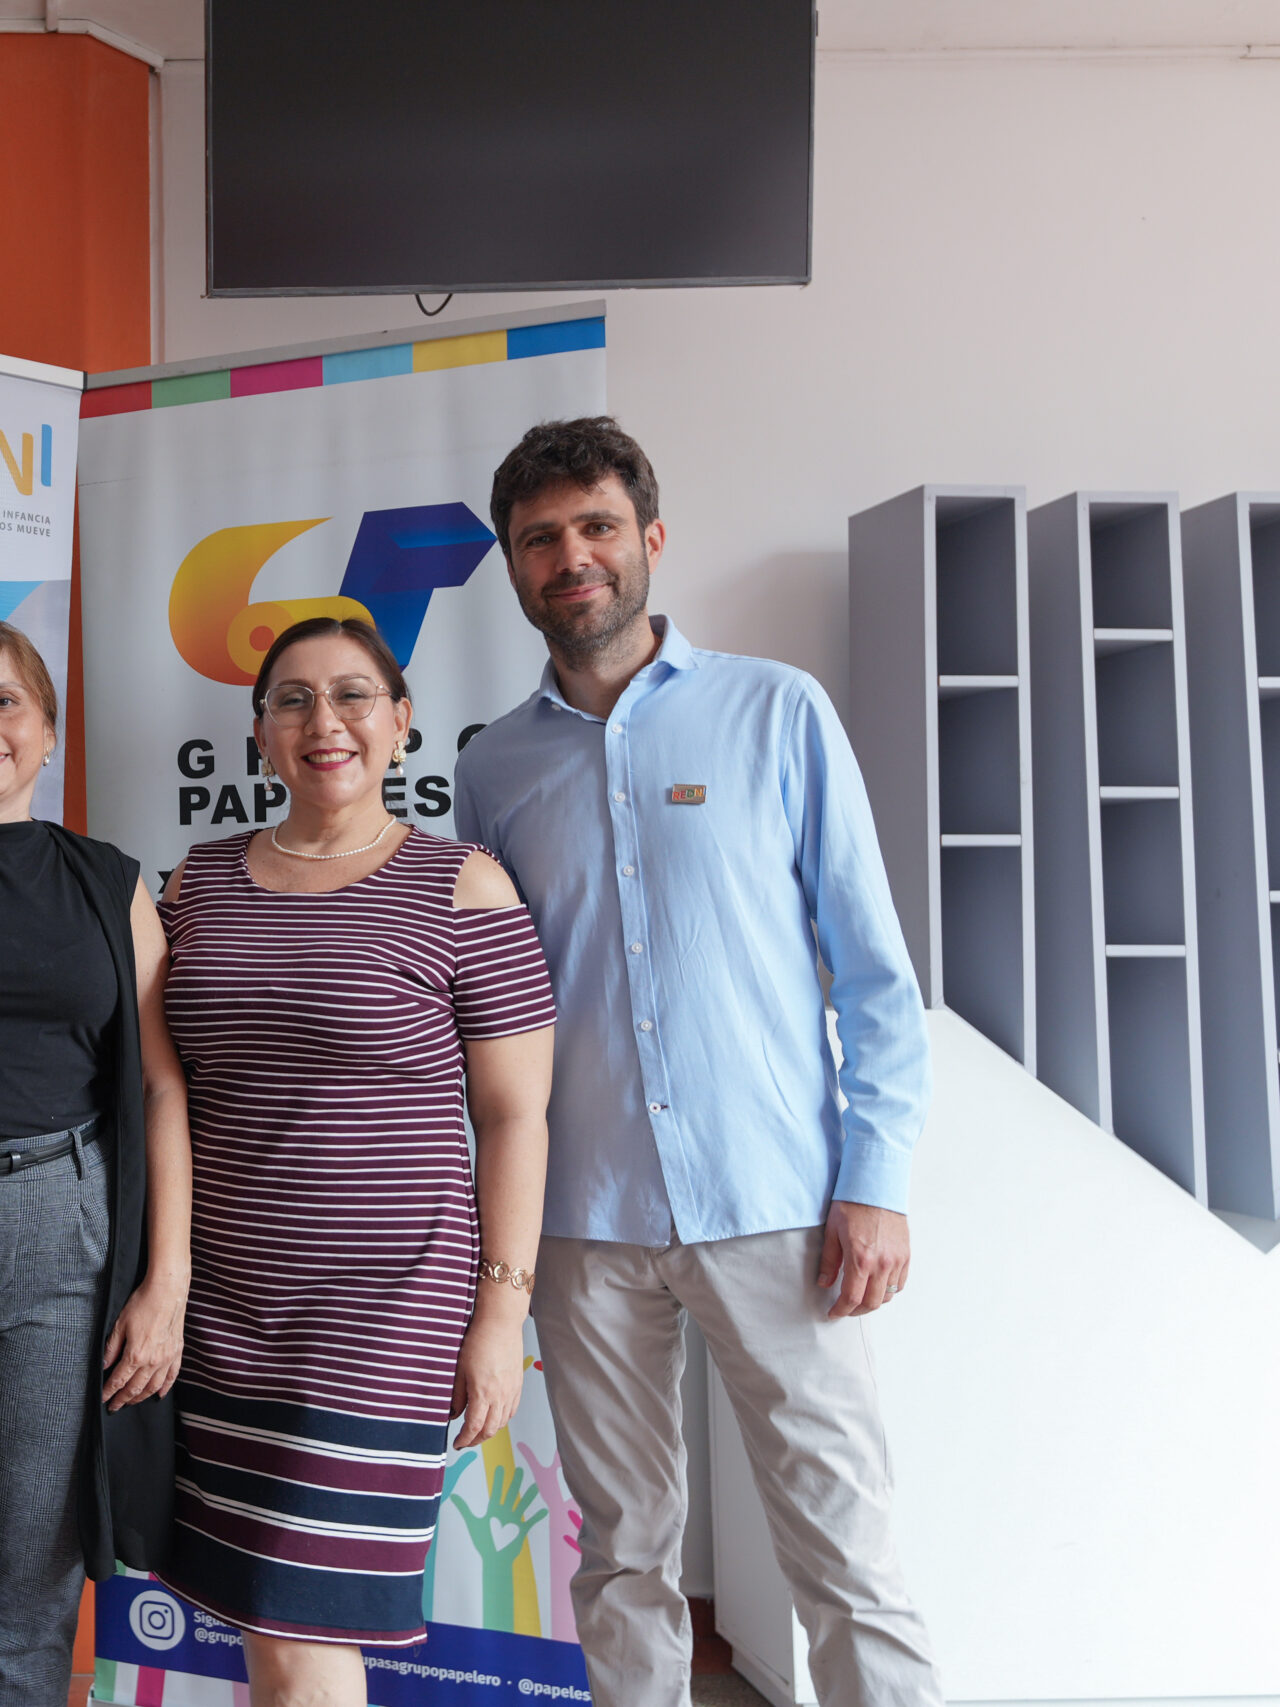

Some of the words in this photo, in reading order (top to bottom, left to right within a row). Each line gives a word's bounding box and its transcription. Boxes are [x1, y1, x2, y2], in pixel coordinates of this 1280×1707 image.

[2, 510, 51, 524] INFANCIA
[16, 524, 51, 537] MUEVE
[194, 1627, 244, 1647] @grupo
[362, 1655, 502, 1687] upasagrupopapelero
[518, 1678, 592, 1702] @papeles
